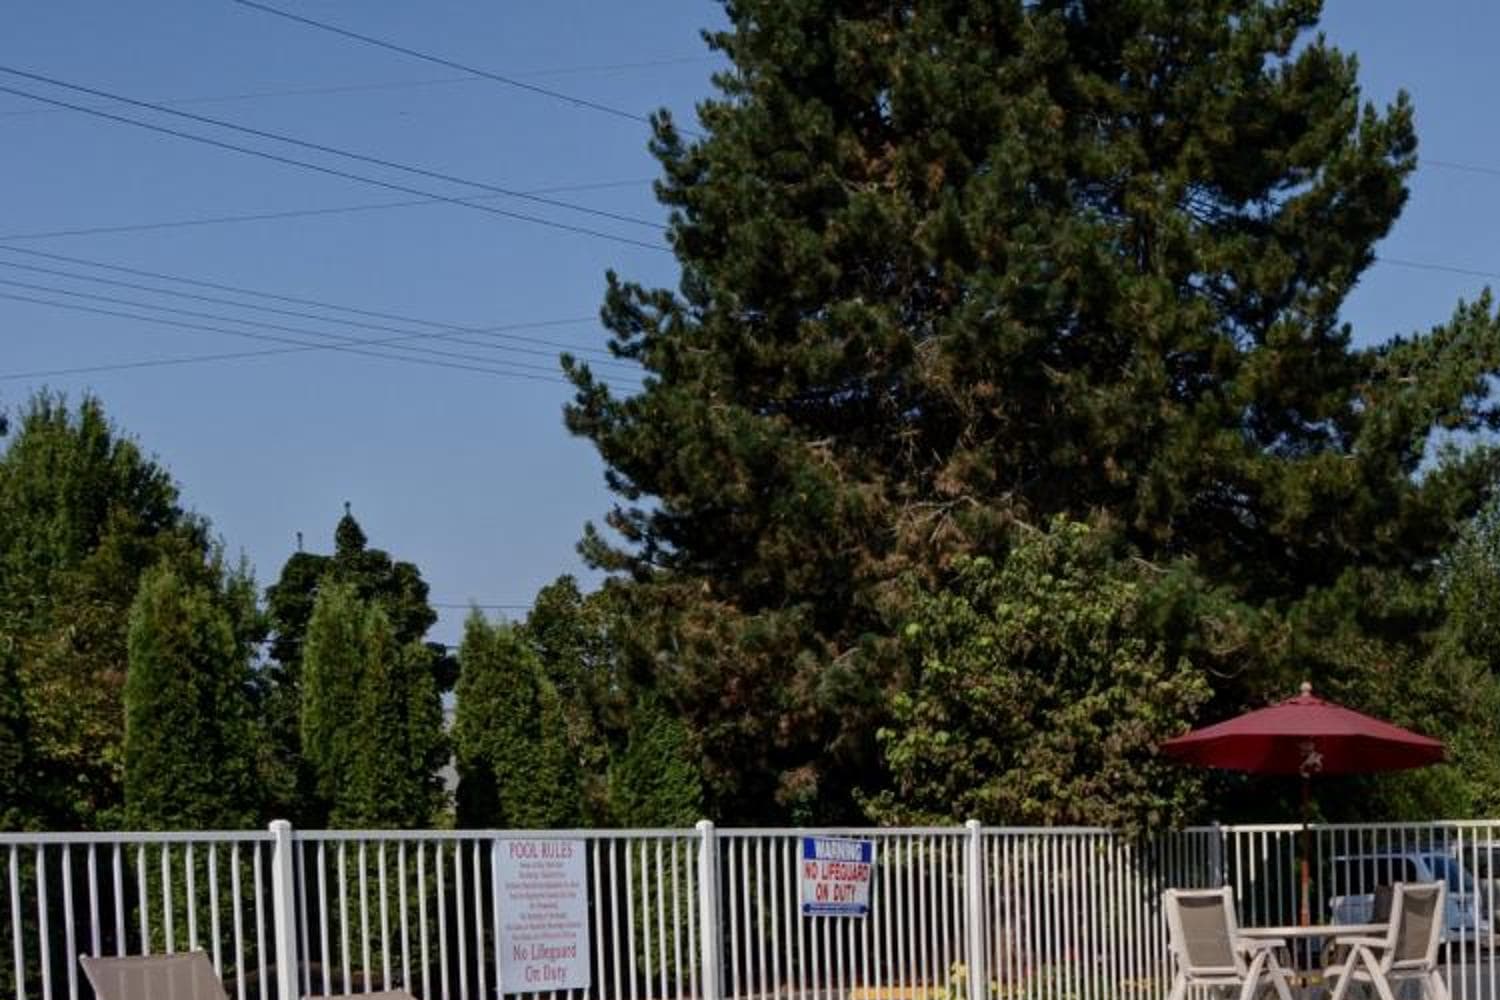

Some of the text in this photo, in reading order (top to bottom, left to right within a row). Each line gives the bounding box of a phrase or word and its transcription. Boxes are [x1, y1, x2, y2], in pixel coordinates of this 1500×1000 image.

[510, 842, 573, 858] POOL RULES
[805, 863, 868, 881] NO LIFEGUARD
[816, 883, 856, 901] ON DUTY
[512, 944, 577, 962] No Lifeguard
[525, 965, 569, 984] On Duty
